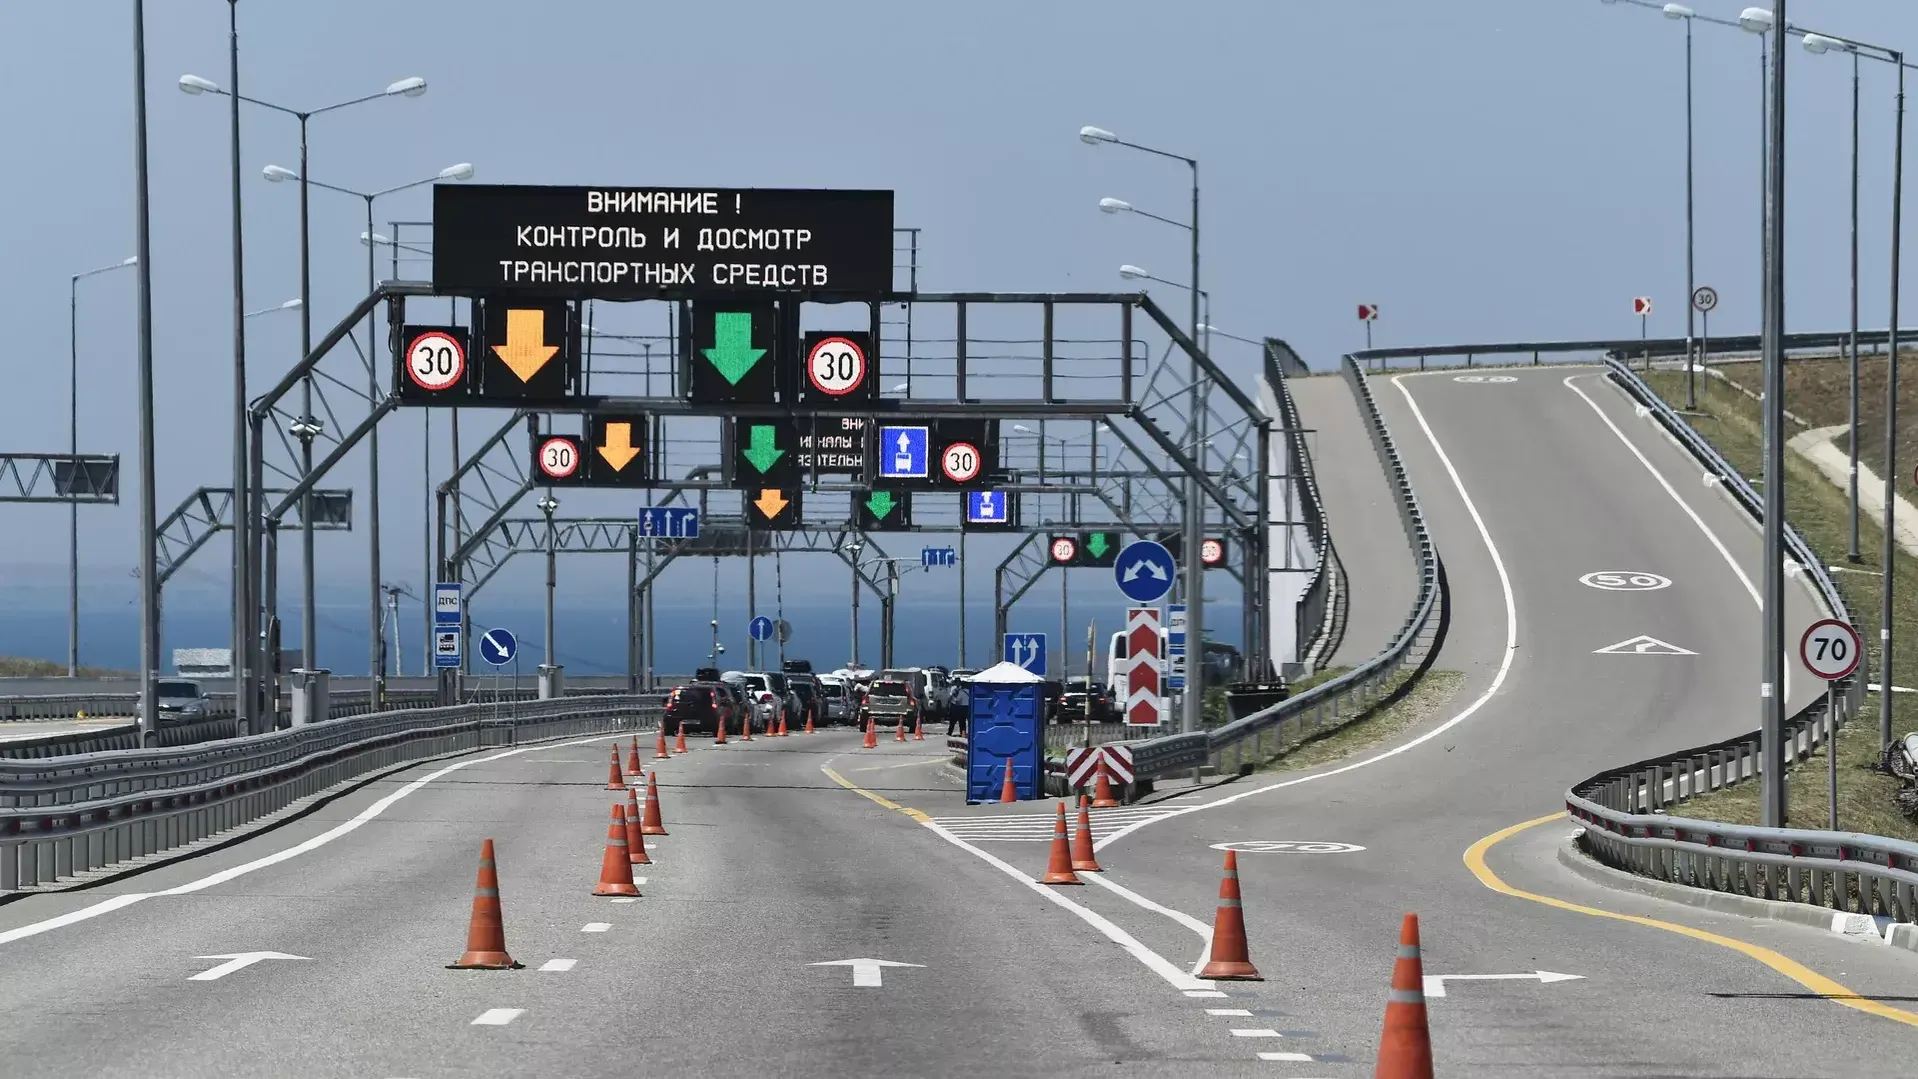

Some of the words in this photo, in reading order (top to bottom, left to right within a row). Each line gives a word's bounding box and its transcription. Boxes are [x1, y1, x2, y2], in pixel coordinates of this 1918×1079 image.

[587, 191, 719, 214] ВНИМАНИЕ
[735, 193, 741, 214] !
[517, 226, 647, 248] КОНТРОЛЬ
[663, 227, 680, 249] И
[697, 228, 812, 251] ДОСМОТР
[499, 260, 696, 285] ТРАНСПОРТНЫХ
[712, 263, 828, 287] СРЕДСТВ
[418, 346, 453, 376] 30
[820, 352, 853, 380] 30
[547, 448, 570, 467] 30
[950, 453, 972, 472] 30
[1596, 575, 1658, 586] 50
[438, 597, 458, 605] ДПС
[1814, 638, 1846, 661] 70
